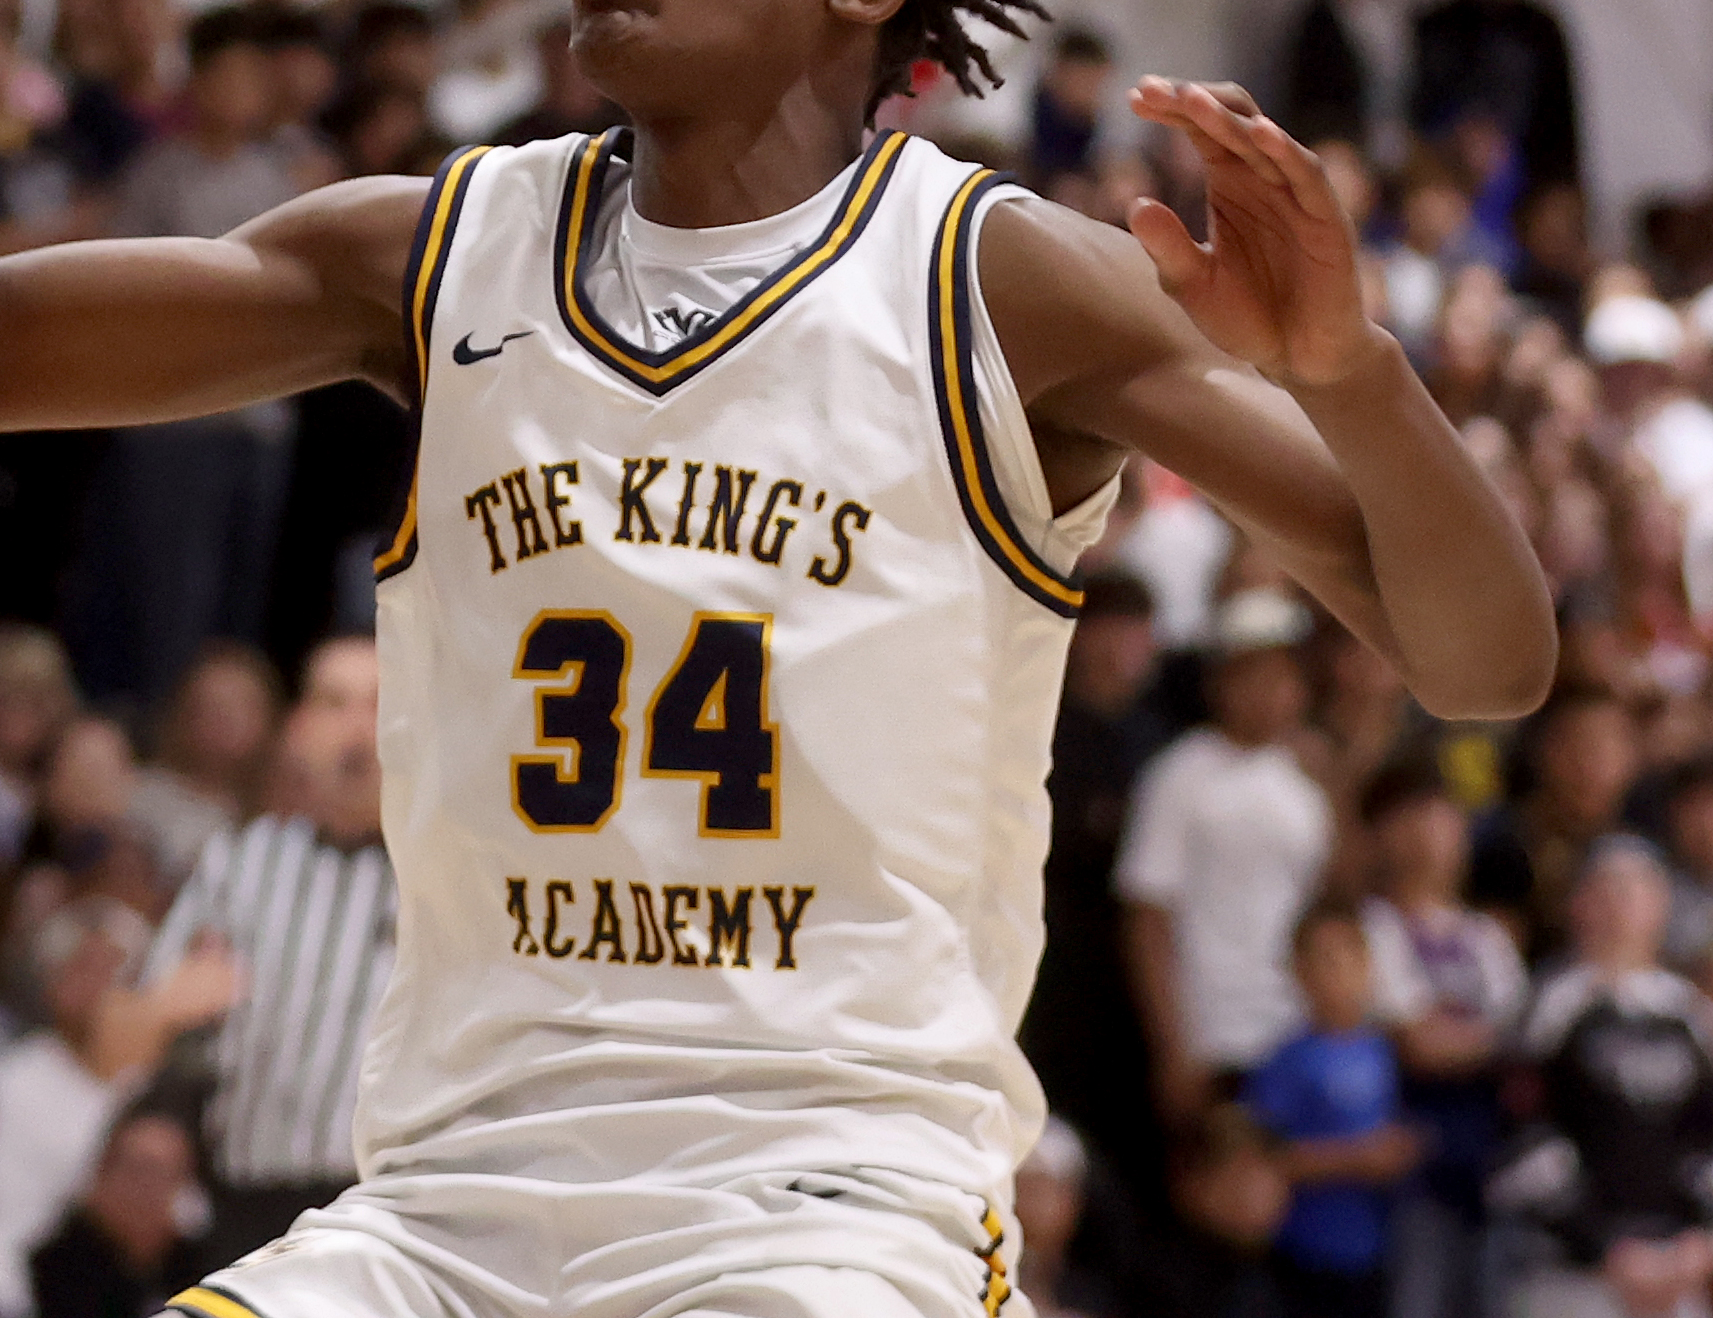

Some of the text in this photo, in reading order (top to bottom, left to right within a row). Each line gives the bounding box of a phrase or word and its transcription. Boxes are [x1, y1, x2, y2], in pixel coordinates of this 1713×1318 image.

[465, 457, 873, 587] THE KING'S
[509, 608, 782, 839] 34
[506, 877, 816, 971] ACADEMY
